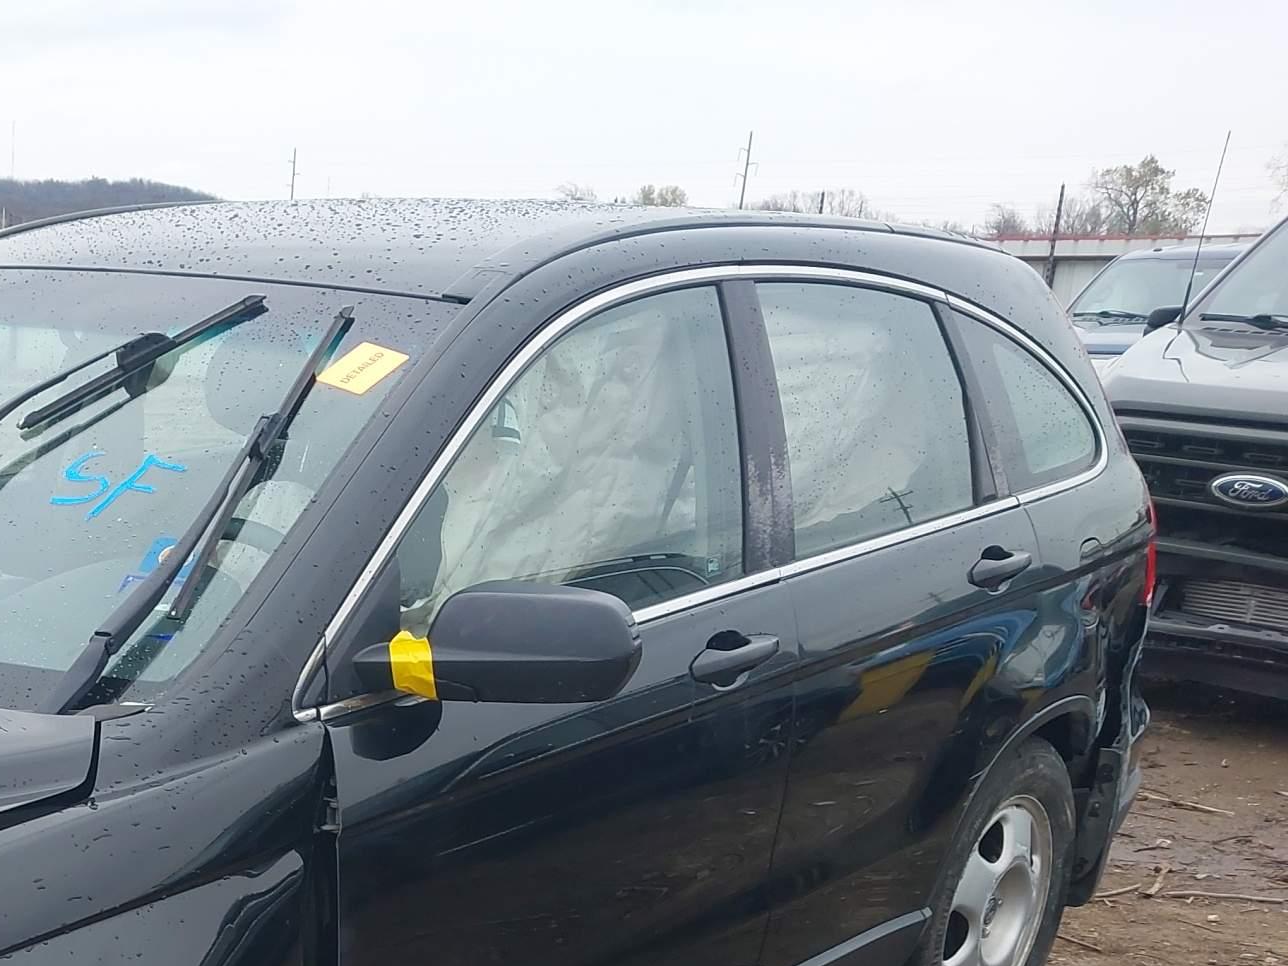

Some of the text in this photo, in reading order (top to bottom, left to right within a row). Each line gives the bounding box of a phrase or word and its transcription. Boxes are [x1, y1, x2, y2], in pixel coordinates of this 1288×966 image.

[340, 352, 385, 384] DETAILED
[49, 451, 187, 522] SF
[1229, 481, 1272, 500] Ford
